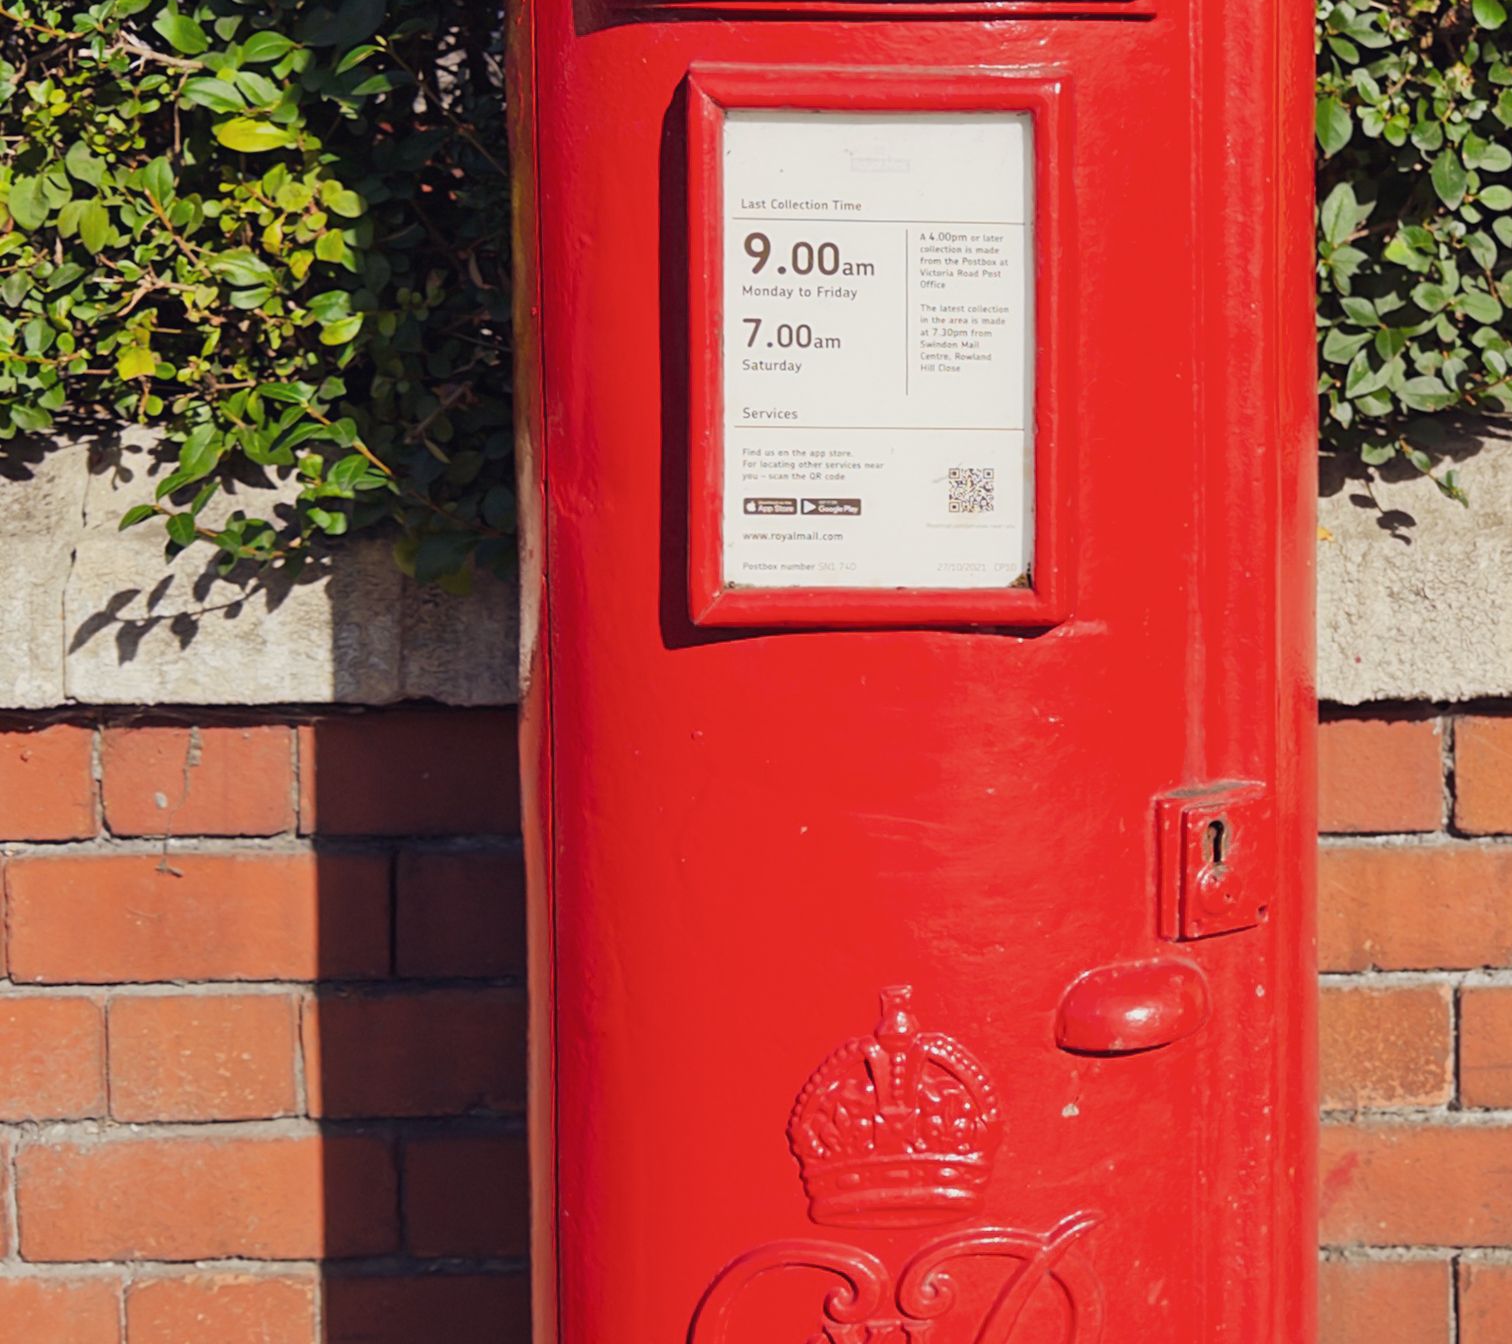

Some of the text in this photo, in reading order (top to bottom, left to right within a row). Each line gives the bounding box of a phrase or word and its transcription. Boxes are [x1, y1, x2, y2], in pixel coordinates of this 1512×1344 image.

[741, 199, 861, 211] Last Collection Time
[929, 232, 967, 242] 4.00pm
[744, 232, 874, 276] 9.00am
[965, 246, 972, 254] is
[962, 257, 996, 266] Postbox
[920, 269, 1001, 278] Victoria Road Post
[920, 280, 945, 288] Office
[743, 286, 857, 300] Monday to Friday
[921, 304, 936, 312] The
[743, 318, 840, 348] 7.00am
[932, 328, 968, 338] 7.30pm
[971, 329, 992, 337] from
[920, 340, 958, 348] Swindon
[955, 352, 991, 360] Rowland
[743, 359, 801, 373] Saturday
[938, 364, 960, 372] Close
[743, 407, 797, 419] Services
[743, 448, 761, 456] Find
[743, 460, 757, 468] For
[760, 461, 795, 469] locating
[810, 472, 821, 480] QR
[757, 504, 795, 514] App Store
[818, 504, 859, 514] Google Play
[744, 532, 843, 542] www.royalmail.com
[743, 562, 777, 570] Postbox
